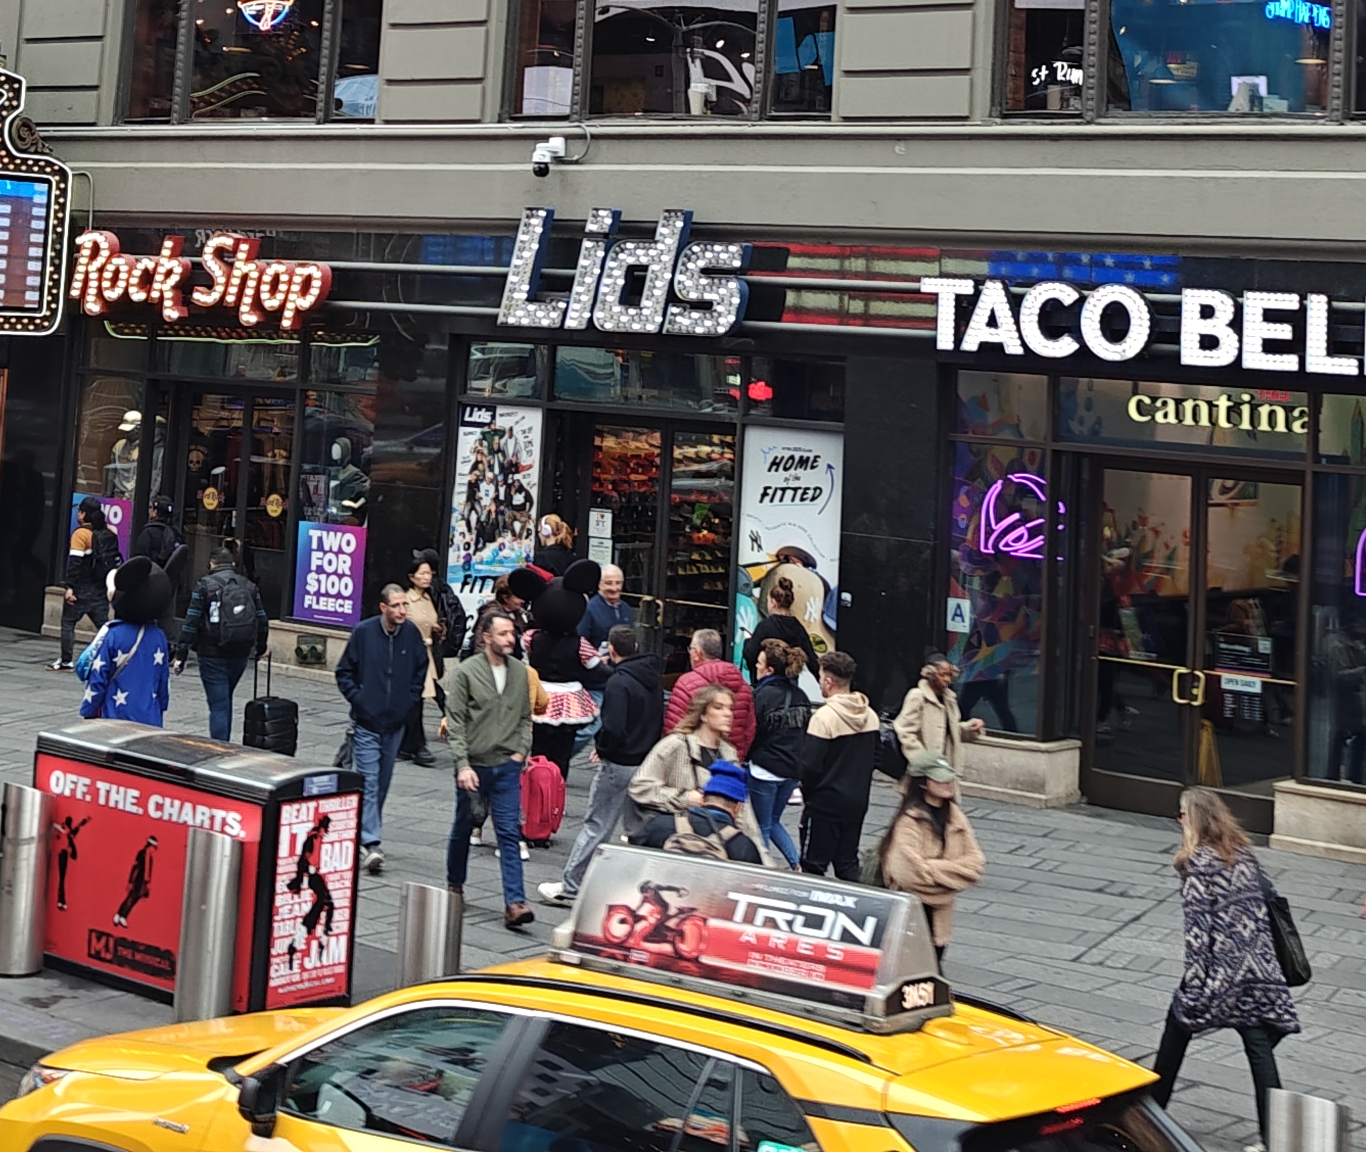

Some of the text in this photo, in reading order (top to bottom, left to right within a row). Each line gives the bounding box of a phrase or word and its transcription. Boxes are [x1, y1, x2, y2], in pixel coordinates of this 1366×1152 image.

[69, 229, 332, 330] Rock Shop
[497, 207, 752, 338] Lids
[921, 276, 1153, 362] TACO
[463, 405, 494, 424] Lids
[1127, 391, 1310, 436] cantina
[768, 454, 821, 473] HOME
[758, 485, 823, 504] FITTED
[308, 529, 356, 553] TWO
[310, 552, 352, 576] FOR
[305, 572, 353, 598] $100
[303, 594, 353, 615] FLEECE
[950, 602, 965, 624] A
[49, 770, 246, 838] OFF. THE. CHARTS.
[280, 801, 317, 825] BEAT
[278, 822, 314, 858] IT
[319, 840, 355, 874] BAD
[810, 889, 859, 909] IMAX
[728, 892, 878, 946] TRON
[90, 931, 116, 960] MJ
[739, 929, 846, 961] ARES
